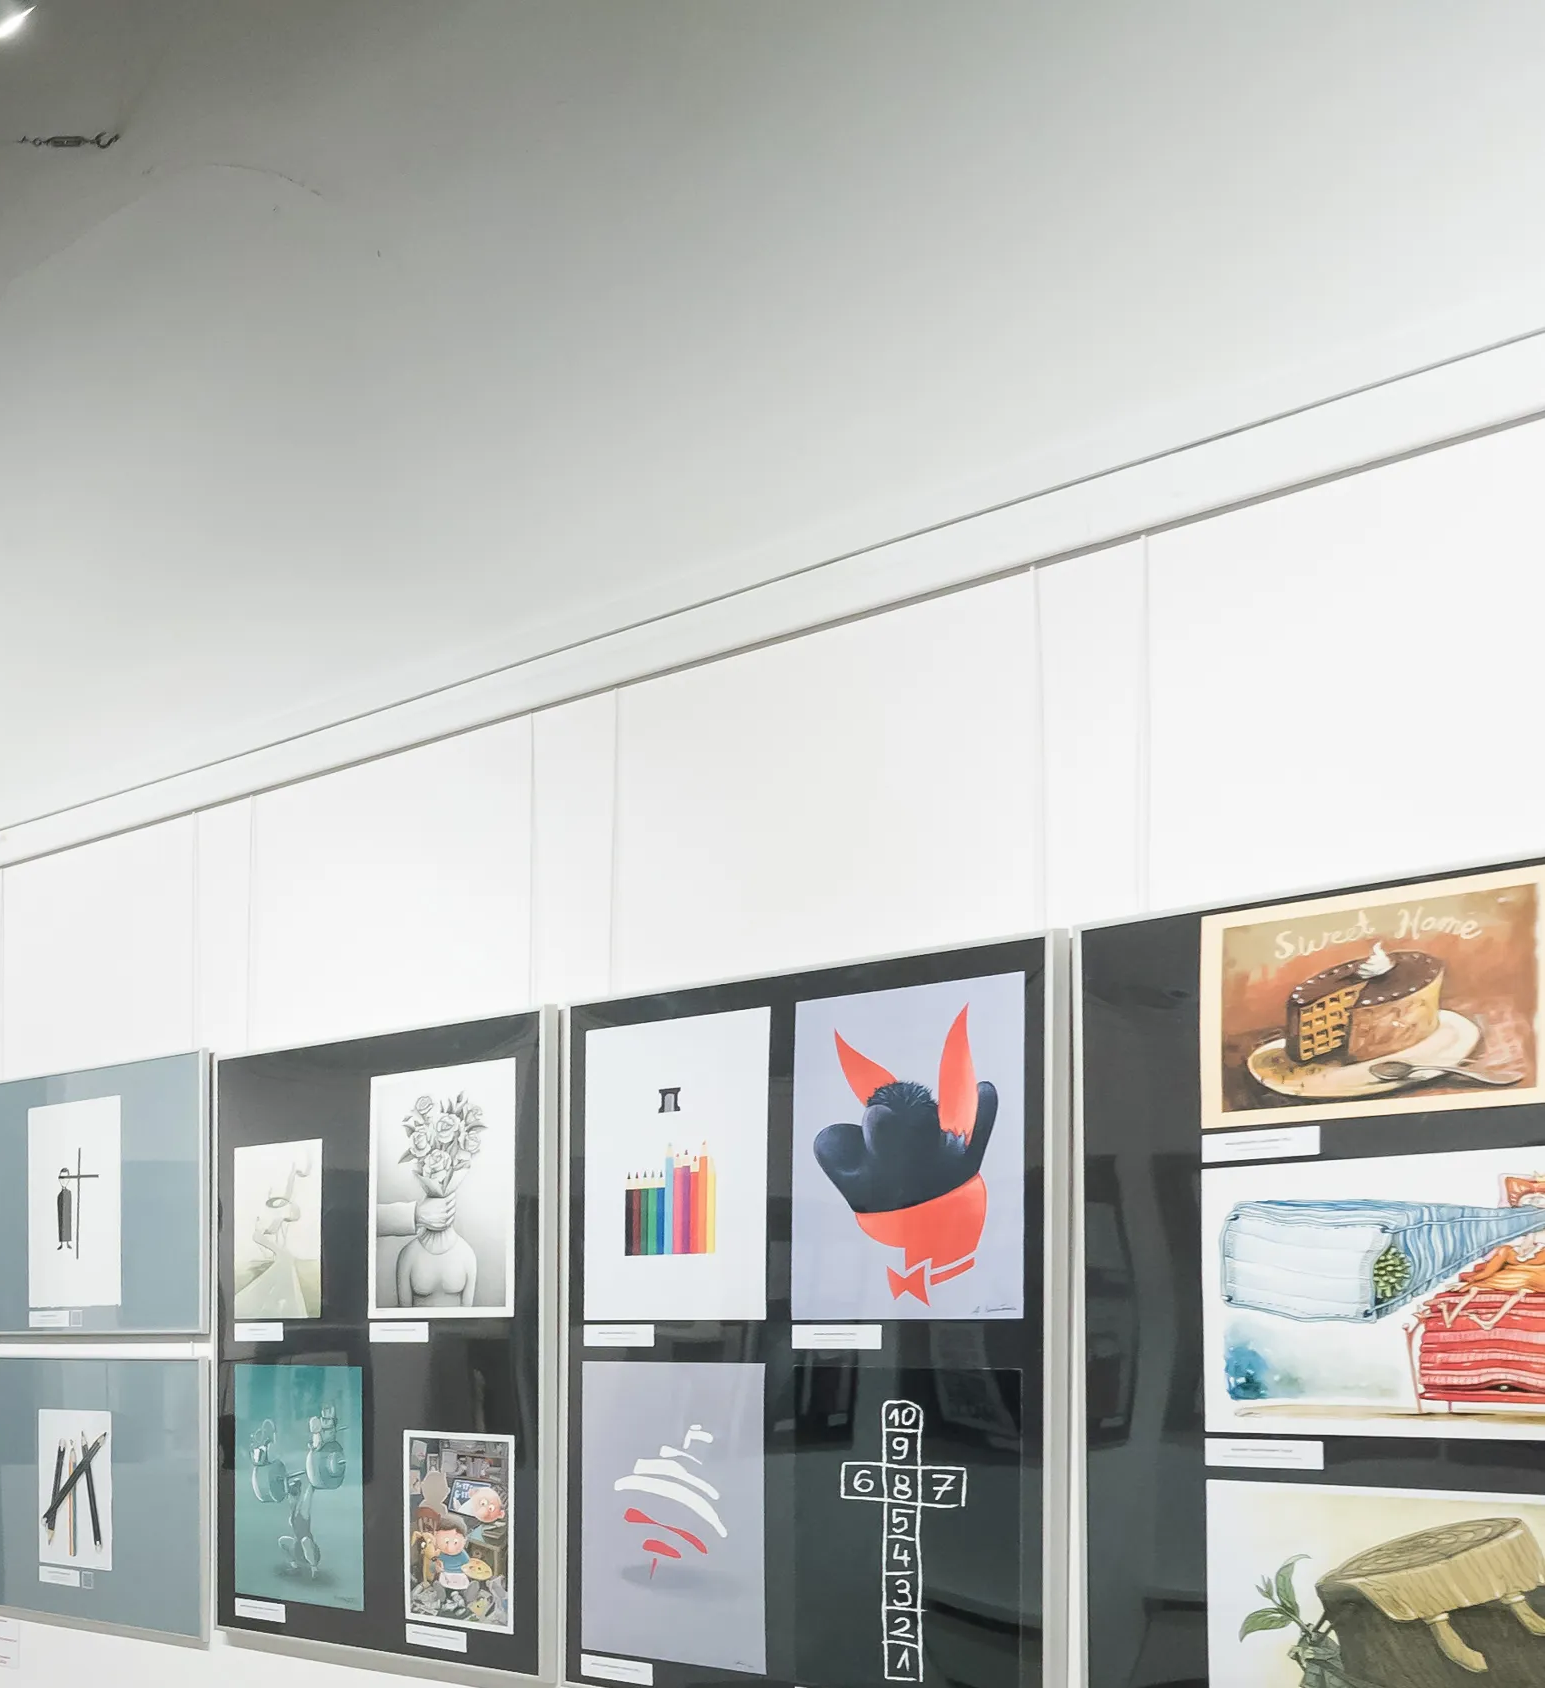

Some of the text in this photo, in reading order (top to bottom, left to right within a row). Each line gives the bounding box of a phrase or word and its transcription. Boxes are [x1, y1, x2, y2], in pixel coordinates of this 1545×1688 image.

[1274, 905, 1483, 959] Sweet Home
[888, 1406, 917, 1427] 10
[891, 1436, 910, 1460] 9
[852, 1469, 957, 1501] 6 8 7
[892, 1508, 916, 1533] 5
[892, 1543, 912, 1568] 4
[892, 1579, 913, 1607] 3
[888, 1616, 916, 1639] 2
[896, 1647, 911, 1672] 1
